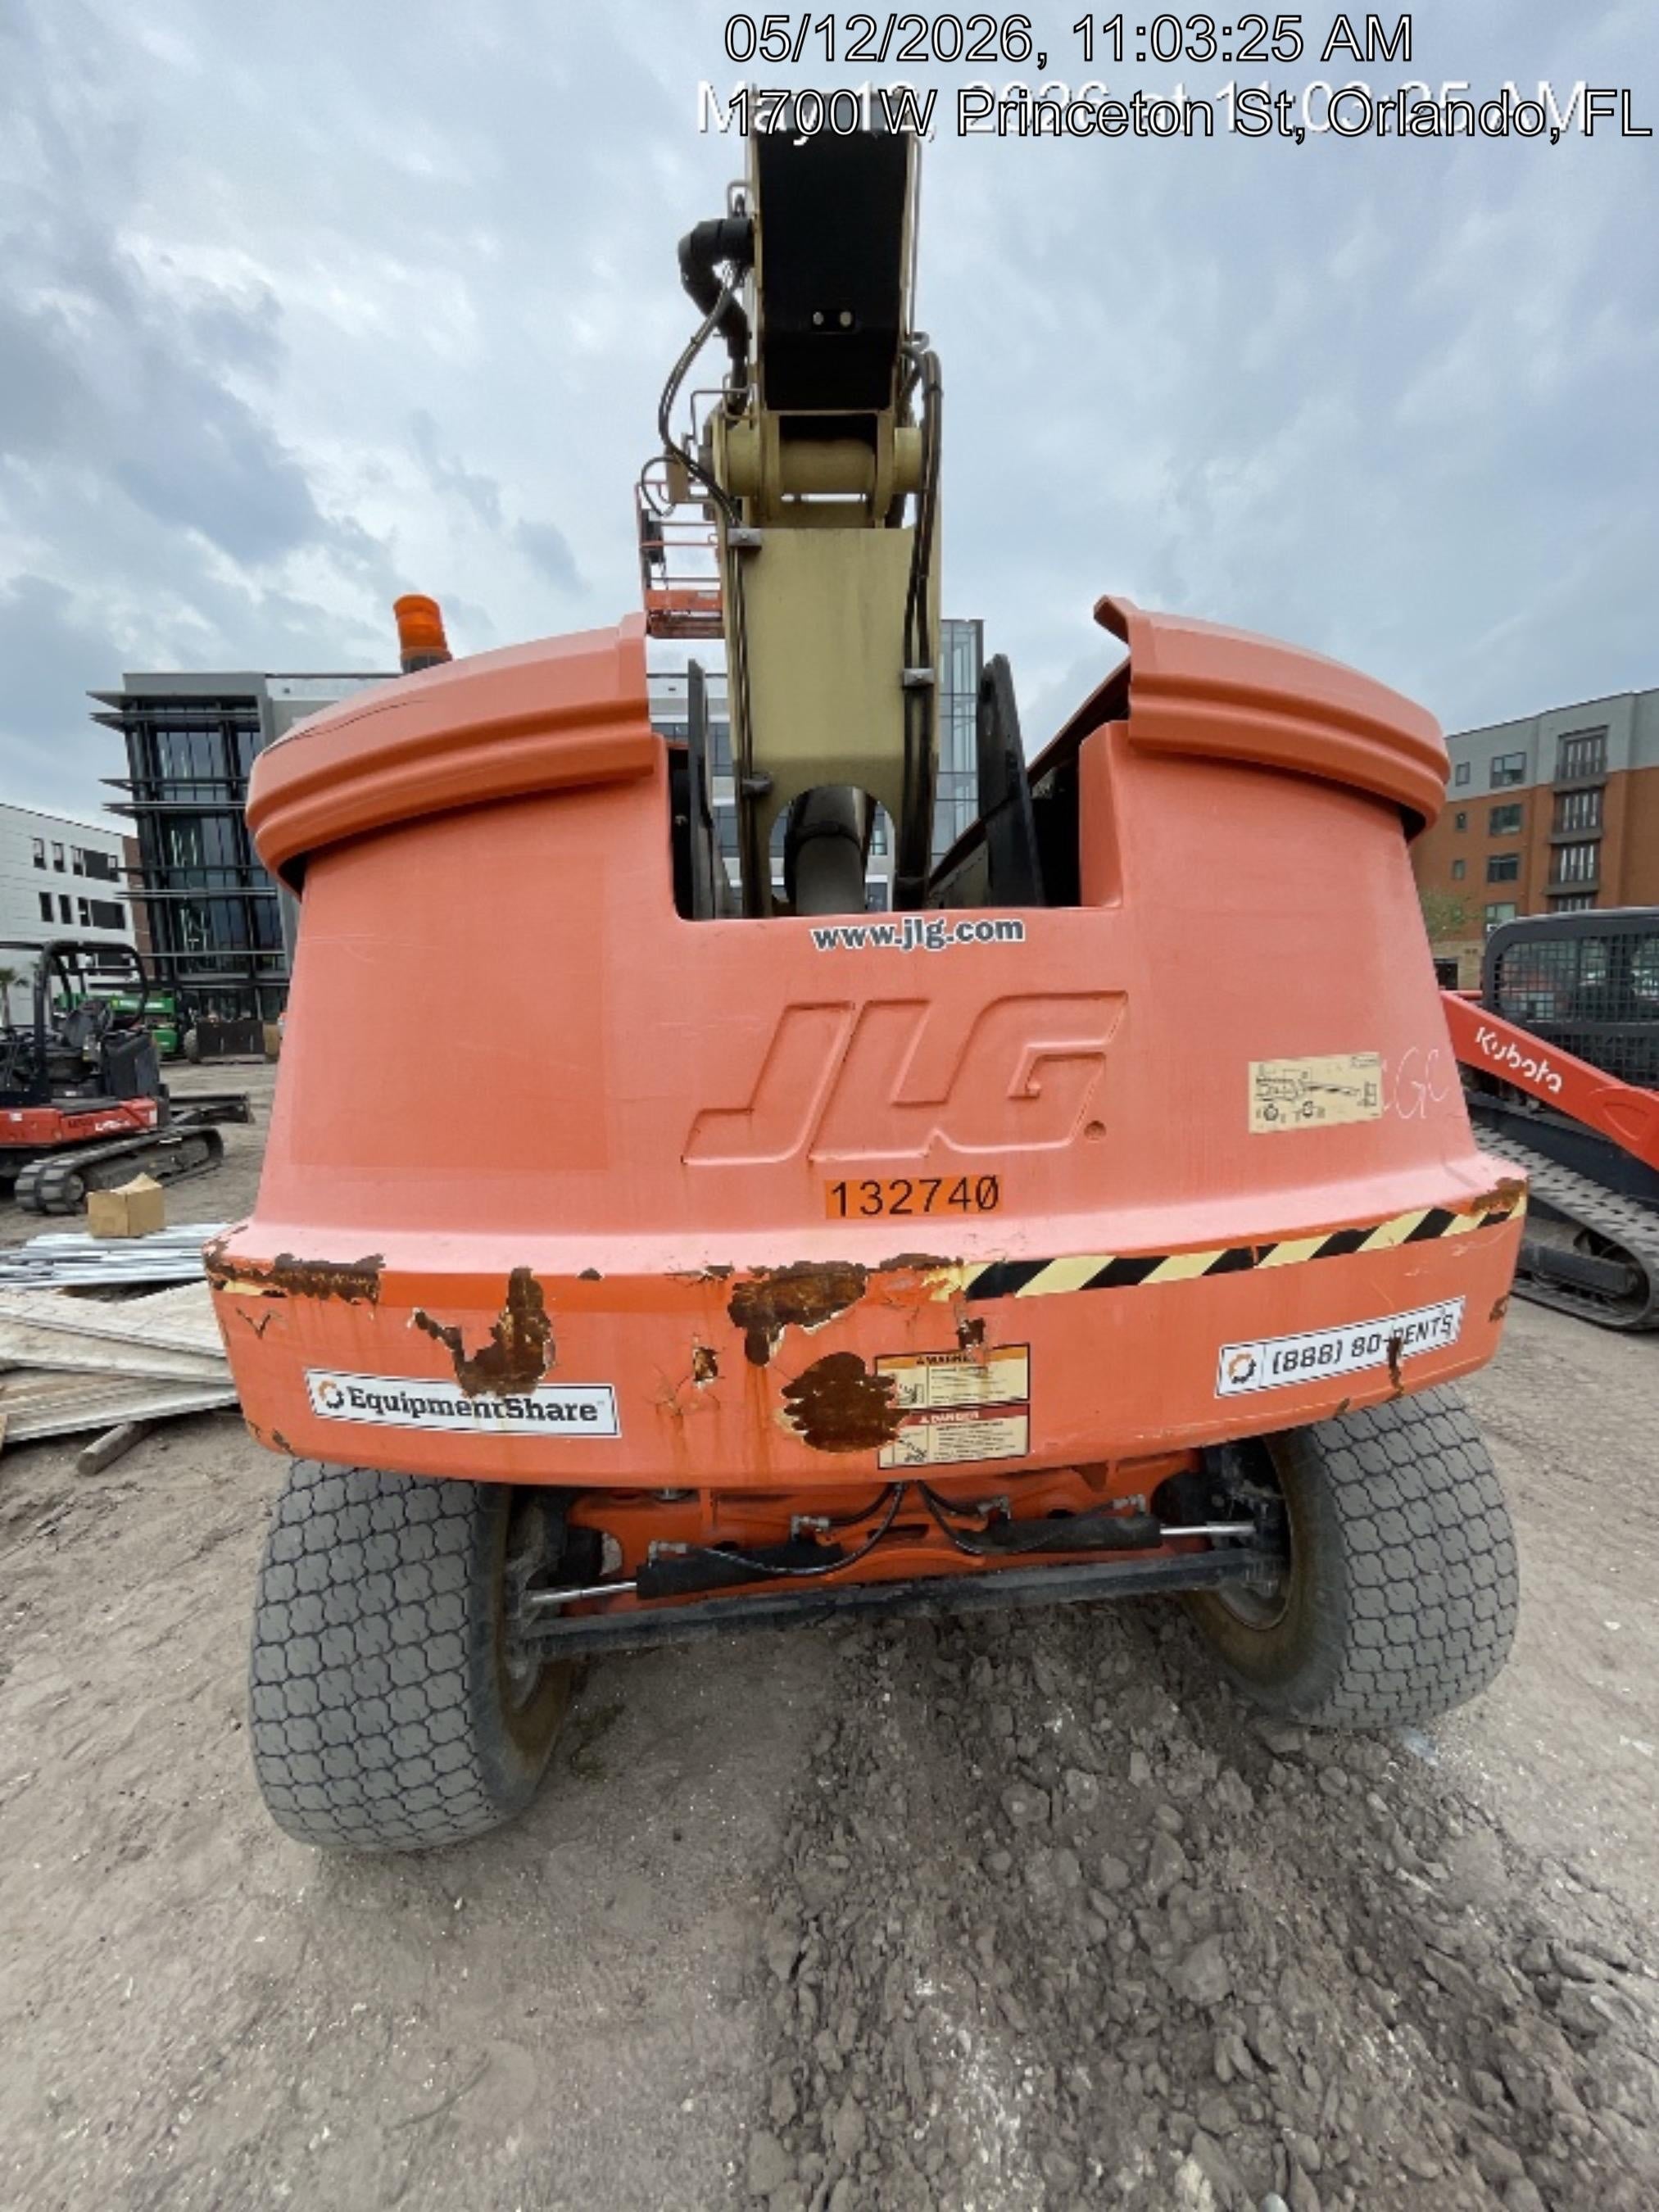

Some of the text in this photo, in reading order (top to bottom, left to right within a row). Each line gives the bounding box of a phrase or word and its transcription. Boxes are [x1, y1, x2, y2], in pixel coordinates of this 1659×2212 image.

[809, 916, 1026, 952] www.jlg.com
[681, 989, 1129, 1167] JLG
[1475, 1026, 1563, 1095] Kubota
[830, 1174, 1000, 1217] 132740
[1272, 1339, 1344, 1376] (888)
[346, 1385, 599, 1422] EquipmentShare
